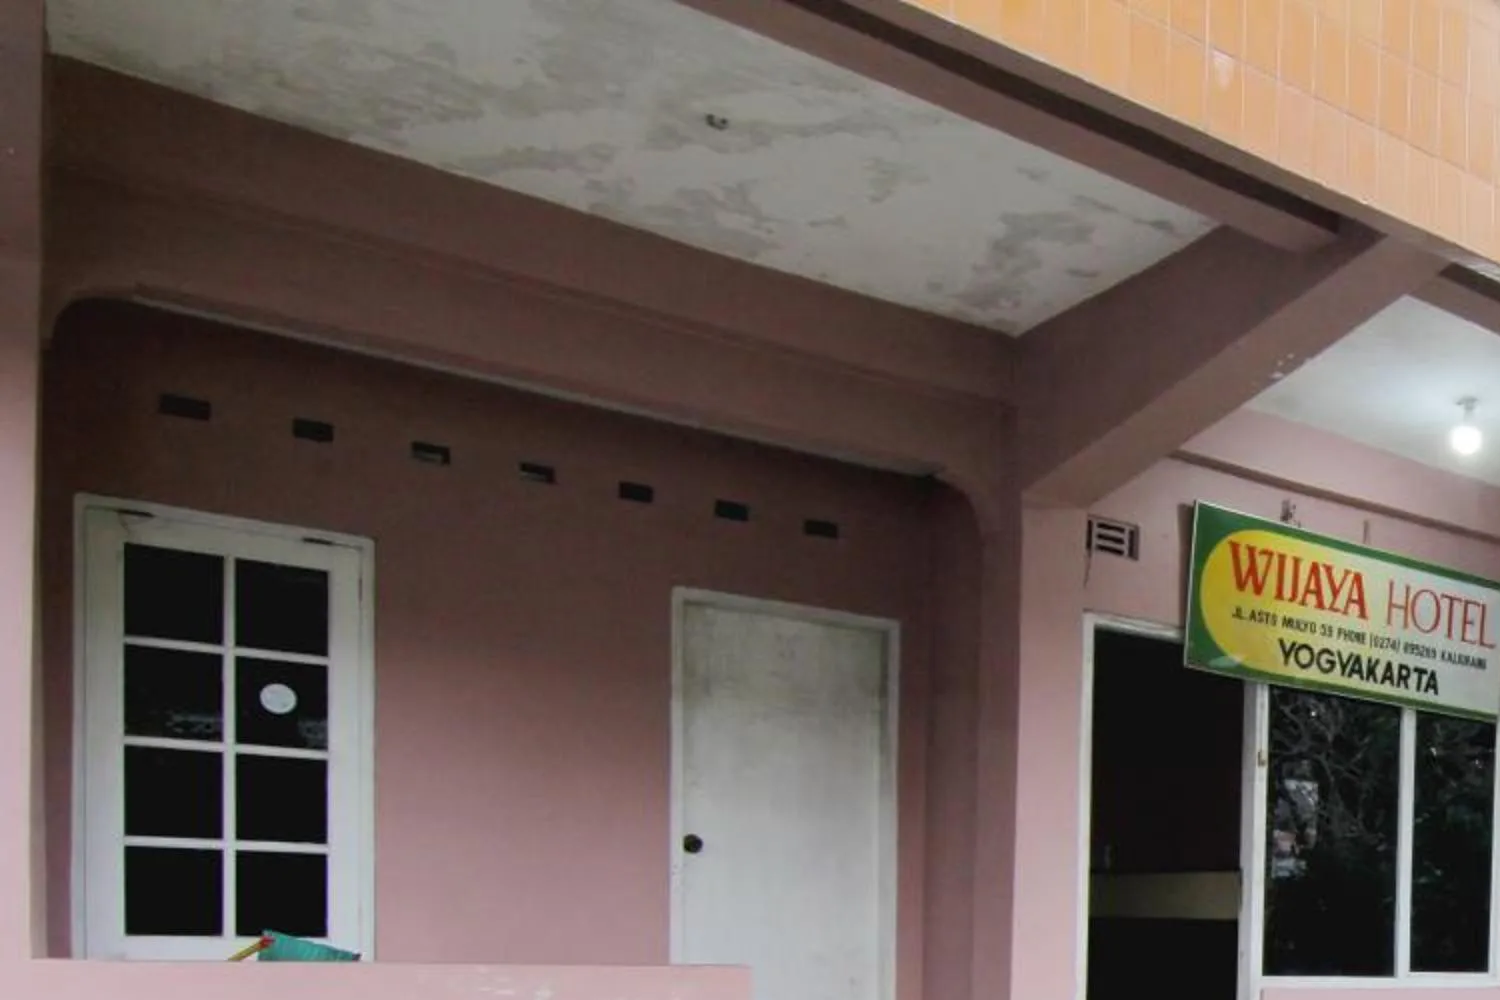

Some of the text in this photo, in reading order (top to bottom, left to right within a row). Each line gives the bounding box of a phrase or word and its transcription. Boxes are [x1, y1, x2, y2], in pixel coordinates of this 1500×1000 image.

[1228, 541, 1496, 650] WIJAYA HOTEL
[1337, 627, 1366, 645] PHONE
[1278, 638, 1439, 695] YOGYAKARTA
